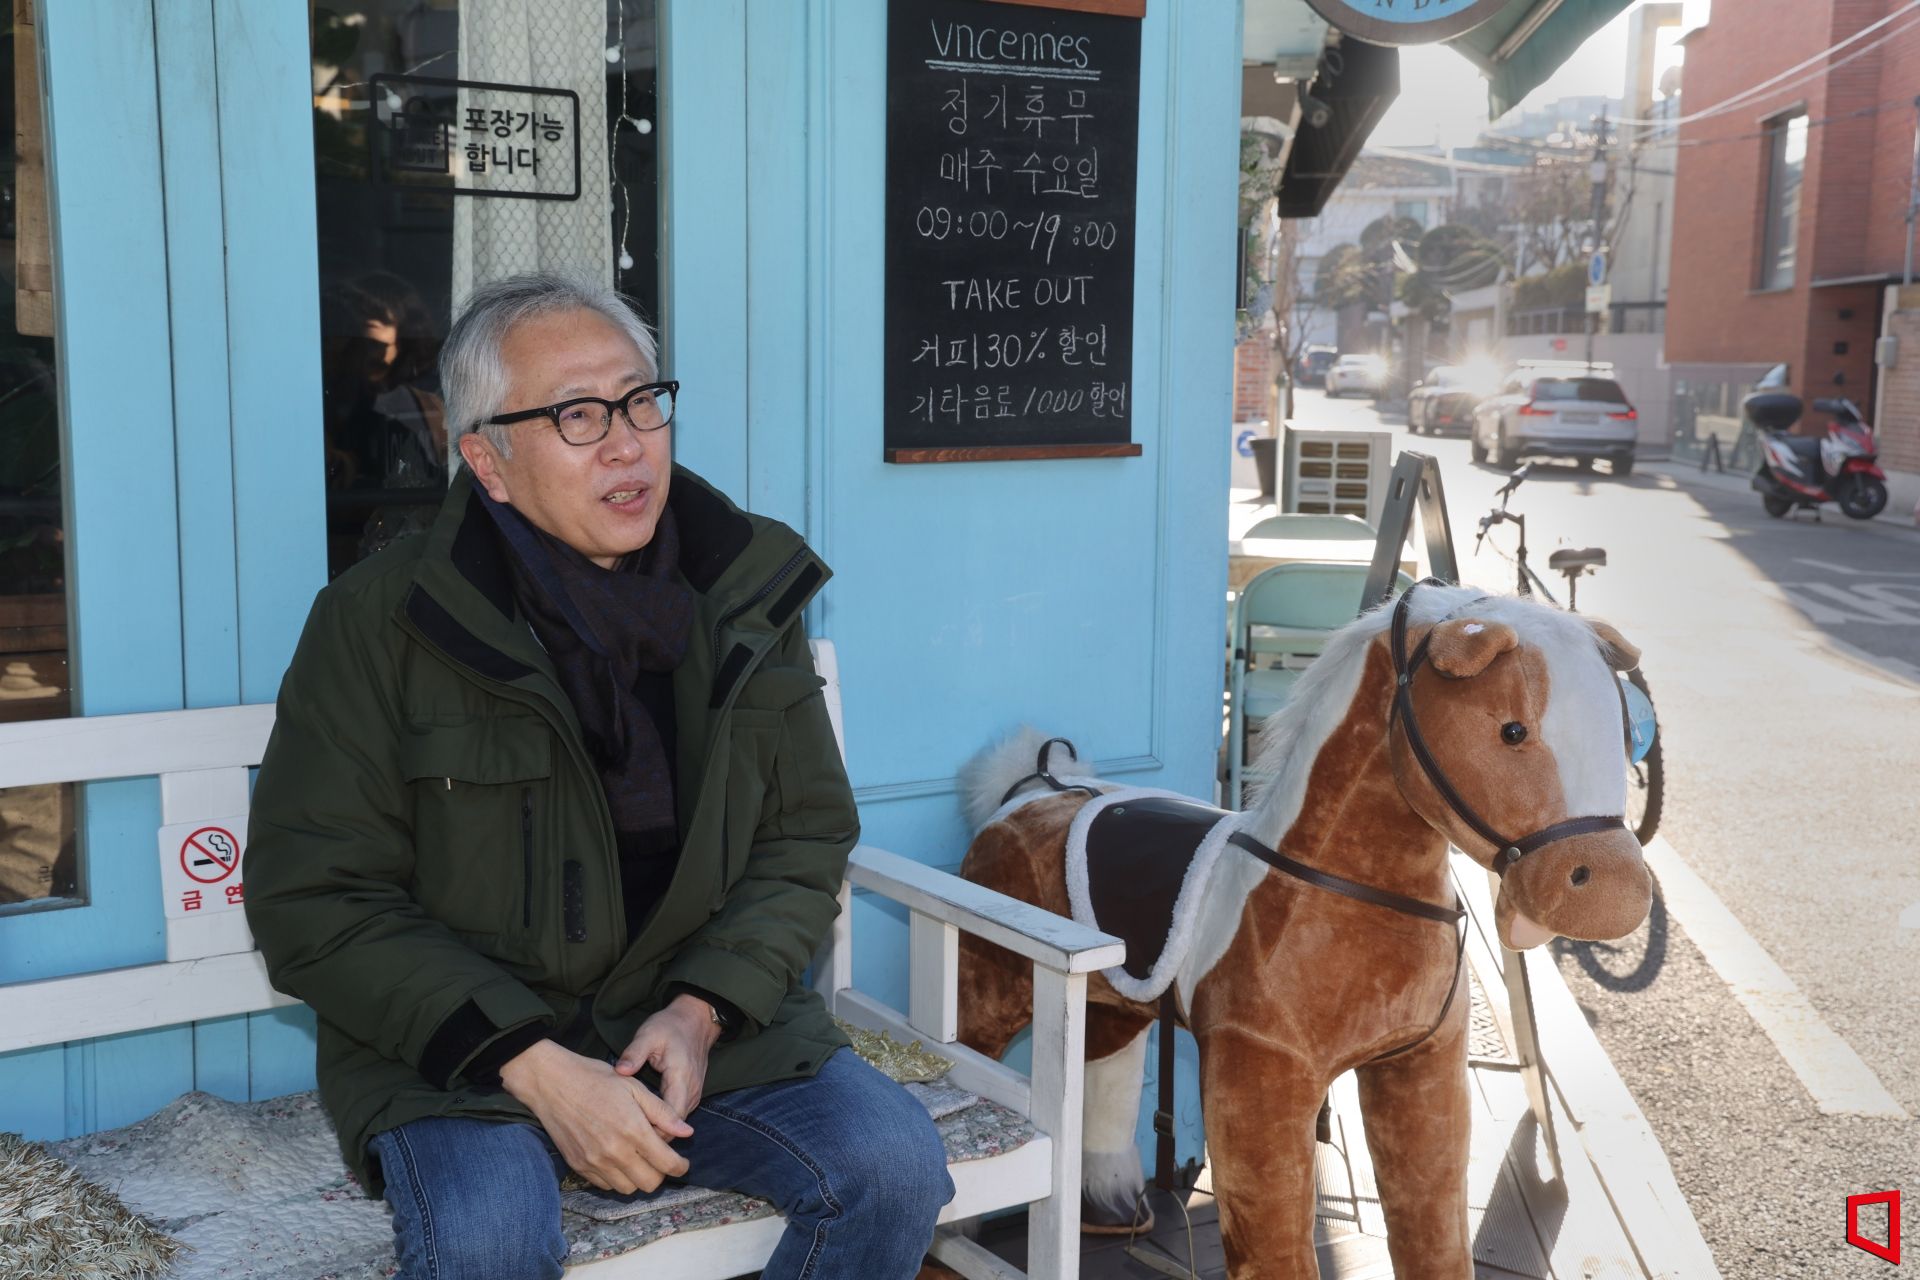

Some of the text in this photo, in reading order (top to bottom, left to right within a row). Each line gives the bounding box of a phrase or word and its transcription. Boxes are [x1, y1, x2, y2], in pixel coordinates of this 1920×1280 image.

[463, 107, 565, 142] 포장가능
[464, 143, 541, 176] 합니다
[940, 146, 1099, 199] 매주 수요일
[941, 275, 1094, 312] TAKE OUT
[1058, 323, 1107, 366] 할인
[1090, 381, 1126, 418] 할인
